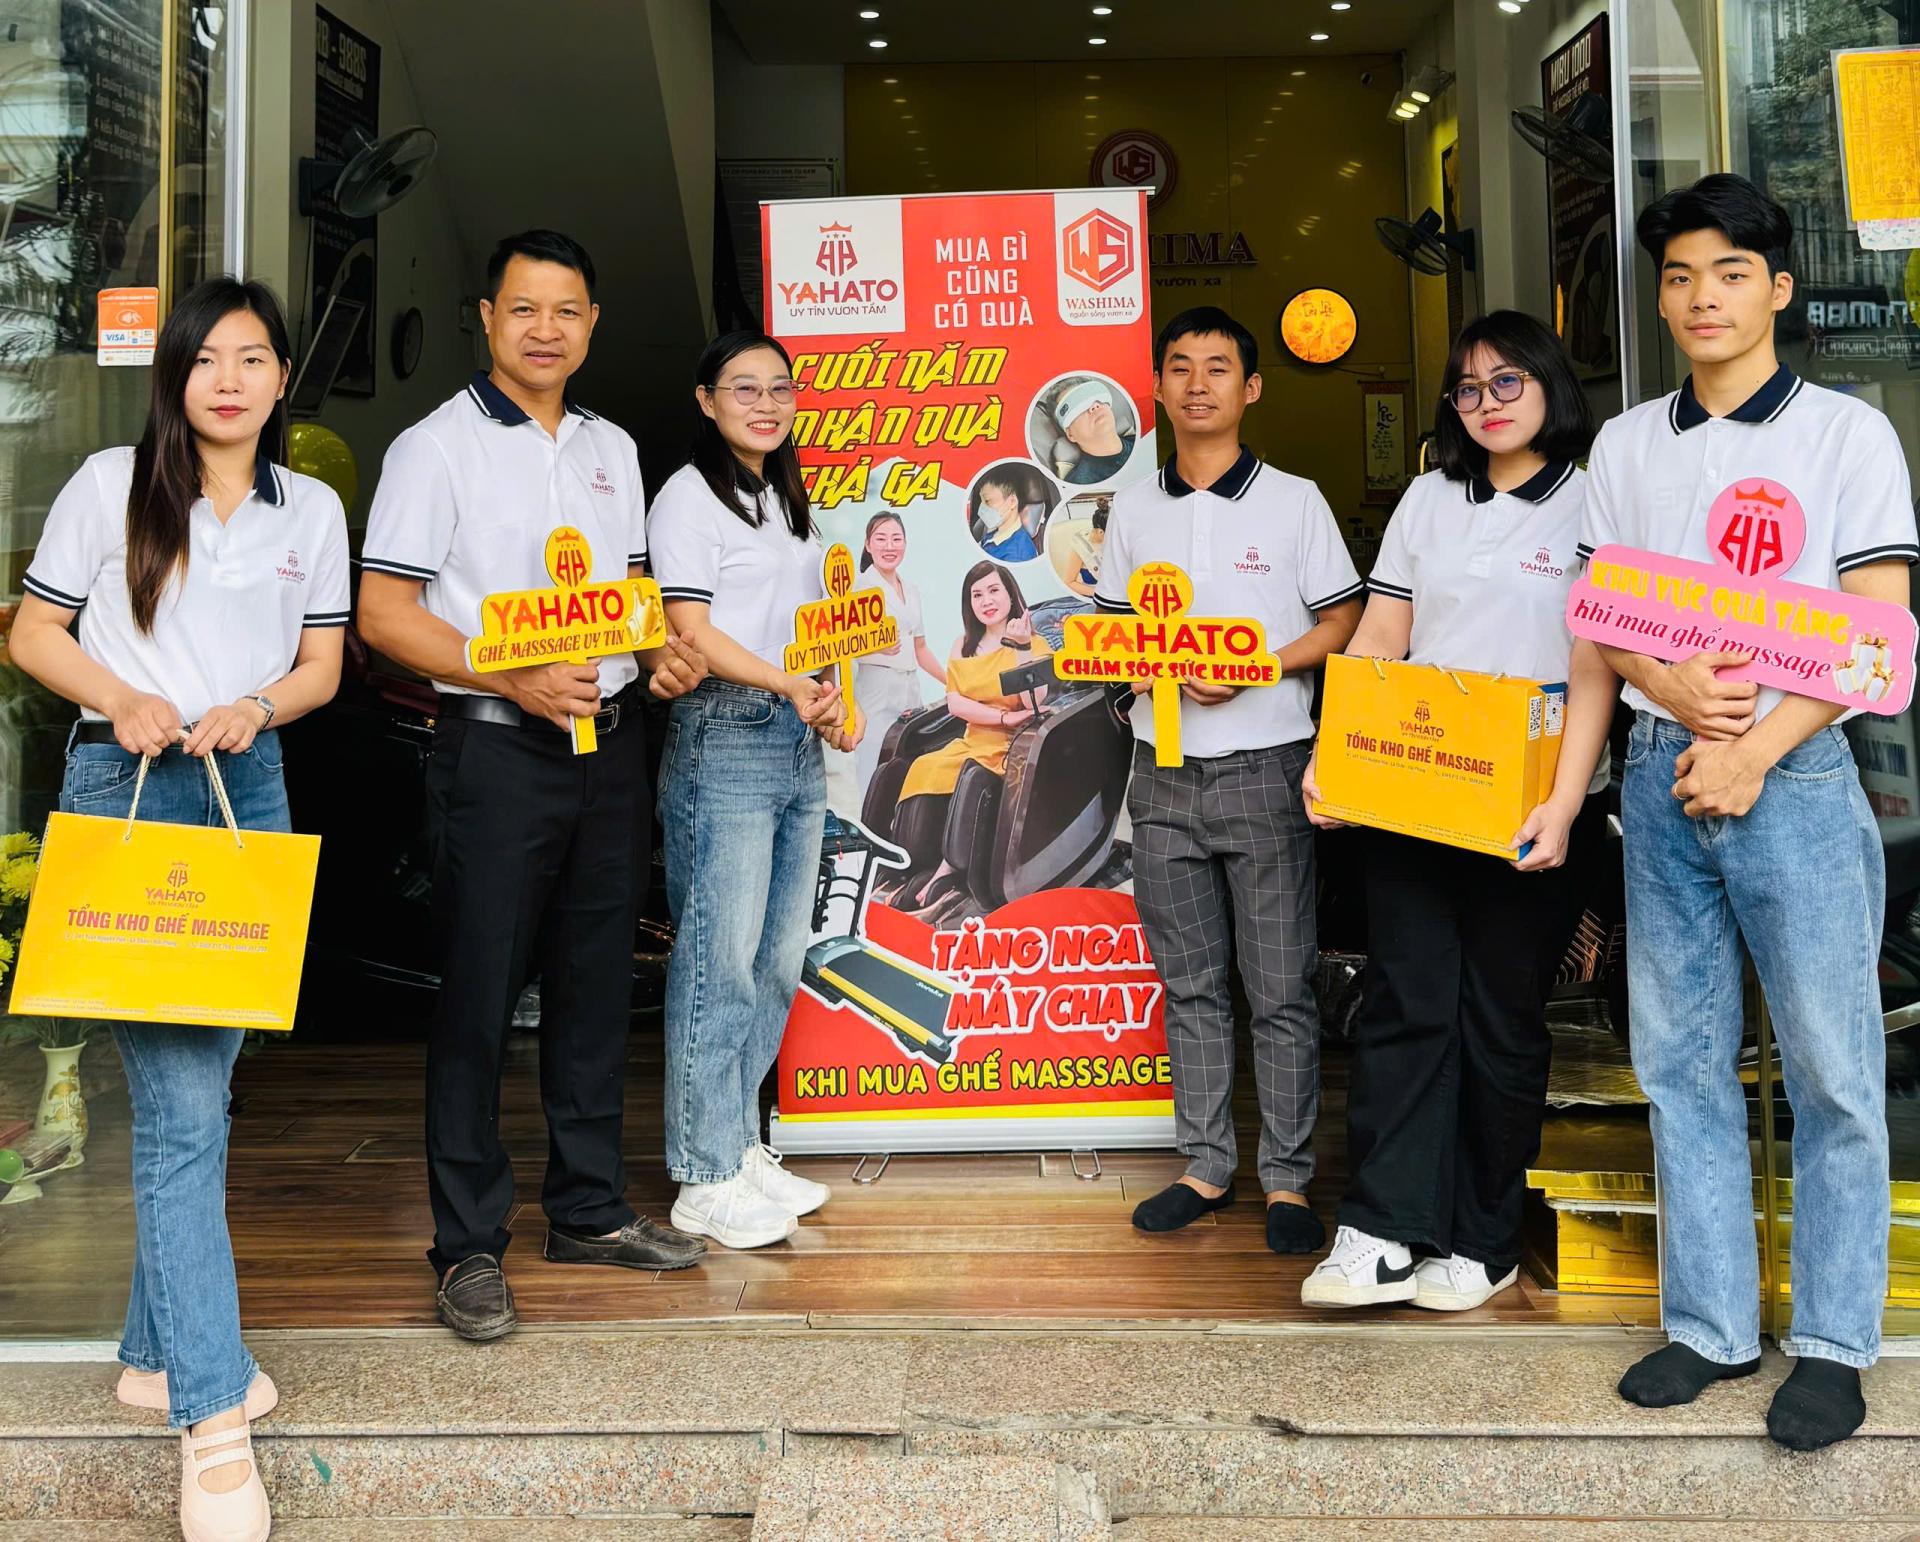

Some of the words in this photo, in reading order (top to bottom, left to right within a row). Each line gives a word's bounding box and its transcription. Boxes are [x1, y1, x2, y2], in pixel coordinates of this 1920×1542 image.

[1572, 32, 1591, 80] 1000
[935, 237, 991, 263] MUA
[1003, 230, 1027, 261] GÌ
[777, 279, 898, 304] YAHATO
[947, 265, 1018, 295] CŨNG
[790, 308, 804, 317] UY
[934, 298, 968, 328] CÓ
[981, 296, 1034, 327] QUÀ
[1066, 297, 1136, 309] WASHIMA
[106, 333, 125, 341] VISA
[792, 338, 899, 394] CUỐI
[897, 341, 1008, 393] NĂM
[792, 400, 912, 452] NHẬN
[913, 394, 1003, 448] QUÀ
[881, 461, 942, 507] GA
[1234, 562, 1271, 572] YAHATO
[1520, 561, 1563, 576] YAHATO
[489, 588, 625, 635] YAHATO
[801, 594, 884, 641] YAHATO
[1590, 561, 1650, 598] KHU
[1774, 598, 1850, 646] TẶNG
[510, 634, 581, 660] MASSSAGE
[584, 632, 602, 650] UY
[604, 625, 625, 646] TÍN
[789, 648, 808, 671] UY
[810, 640, 831, 665] TÍN
[870, 620, 896, 647] TẦM
[1073, 621, 1259, 657] YAHATO
[1615, 612, 1668, 639] mua
[1671, 627, 1722, 651] ghế
[1719, 638, 1832, 681] massage
[1062, 656, 1121, 677] CHĂM
[1125, 657, 1164, 679] SÓC
[1168, 659, 1208, 680] SỨC
[1212, 659, 1274, 682] KHỎE
[1400, 720, 1444, 738] YAHATO
[1380, 740, 1404, 758] KHO
[1408, 745, 1433, 764] GHẾ
[1435, 751, 1494, 777] MASSAGE
[145, 887, 206, 904] YAHATO
[68, 903, 112, 928] TỔNG
[115, 913, 150, 932] KHO
[154, 912, 190, 935] GHẾ
[191, 919, 270, 940] MASSAGE
[933, 918, 1045, 983] TẶNG
[945, 980, 1041, 1030] MÁY
[1046, 985, 1157, 1036] CHẠY
[795, 1066, 847, 1099] KHI
[858, 1063, 929, 1096] MUA
[937, 1048, 1002, 1093] GHẾ
[1010, 1054, 1173, 1090] MASSSAGE
